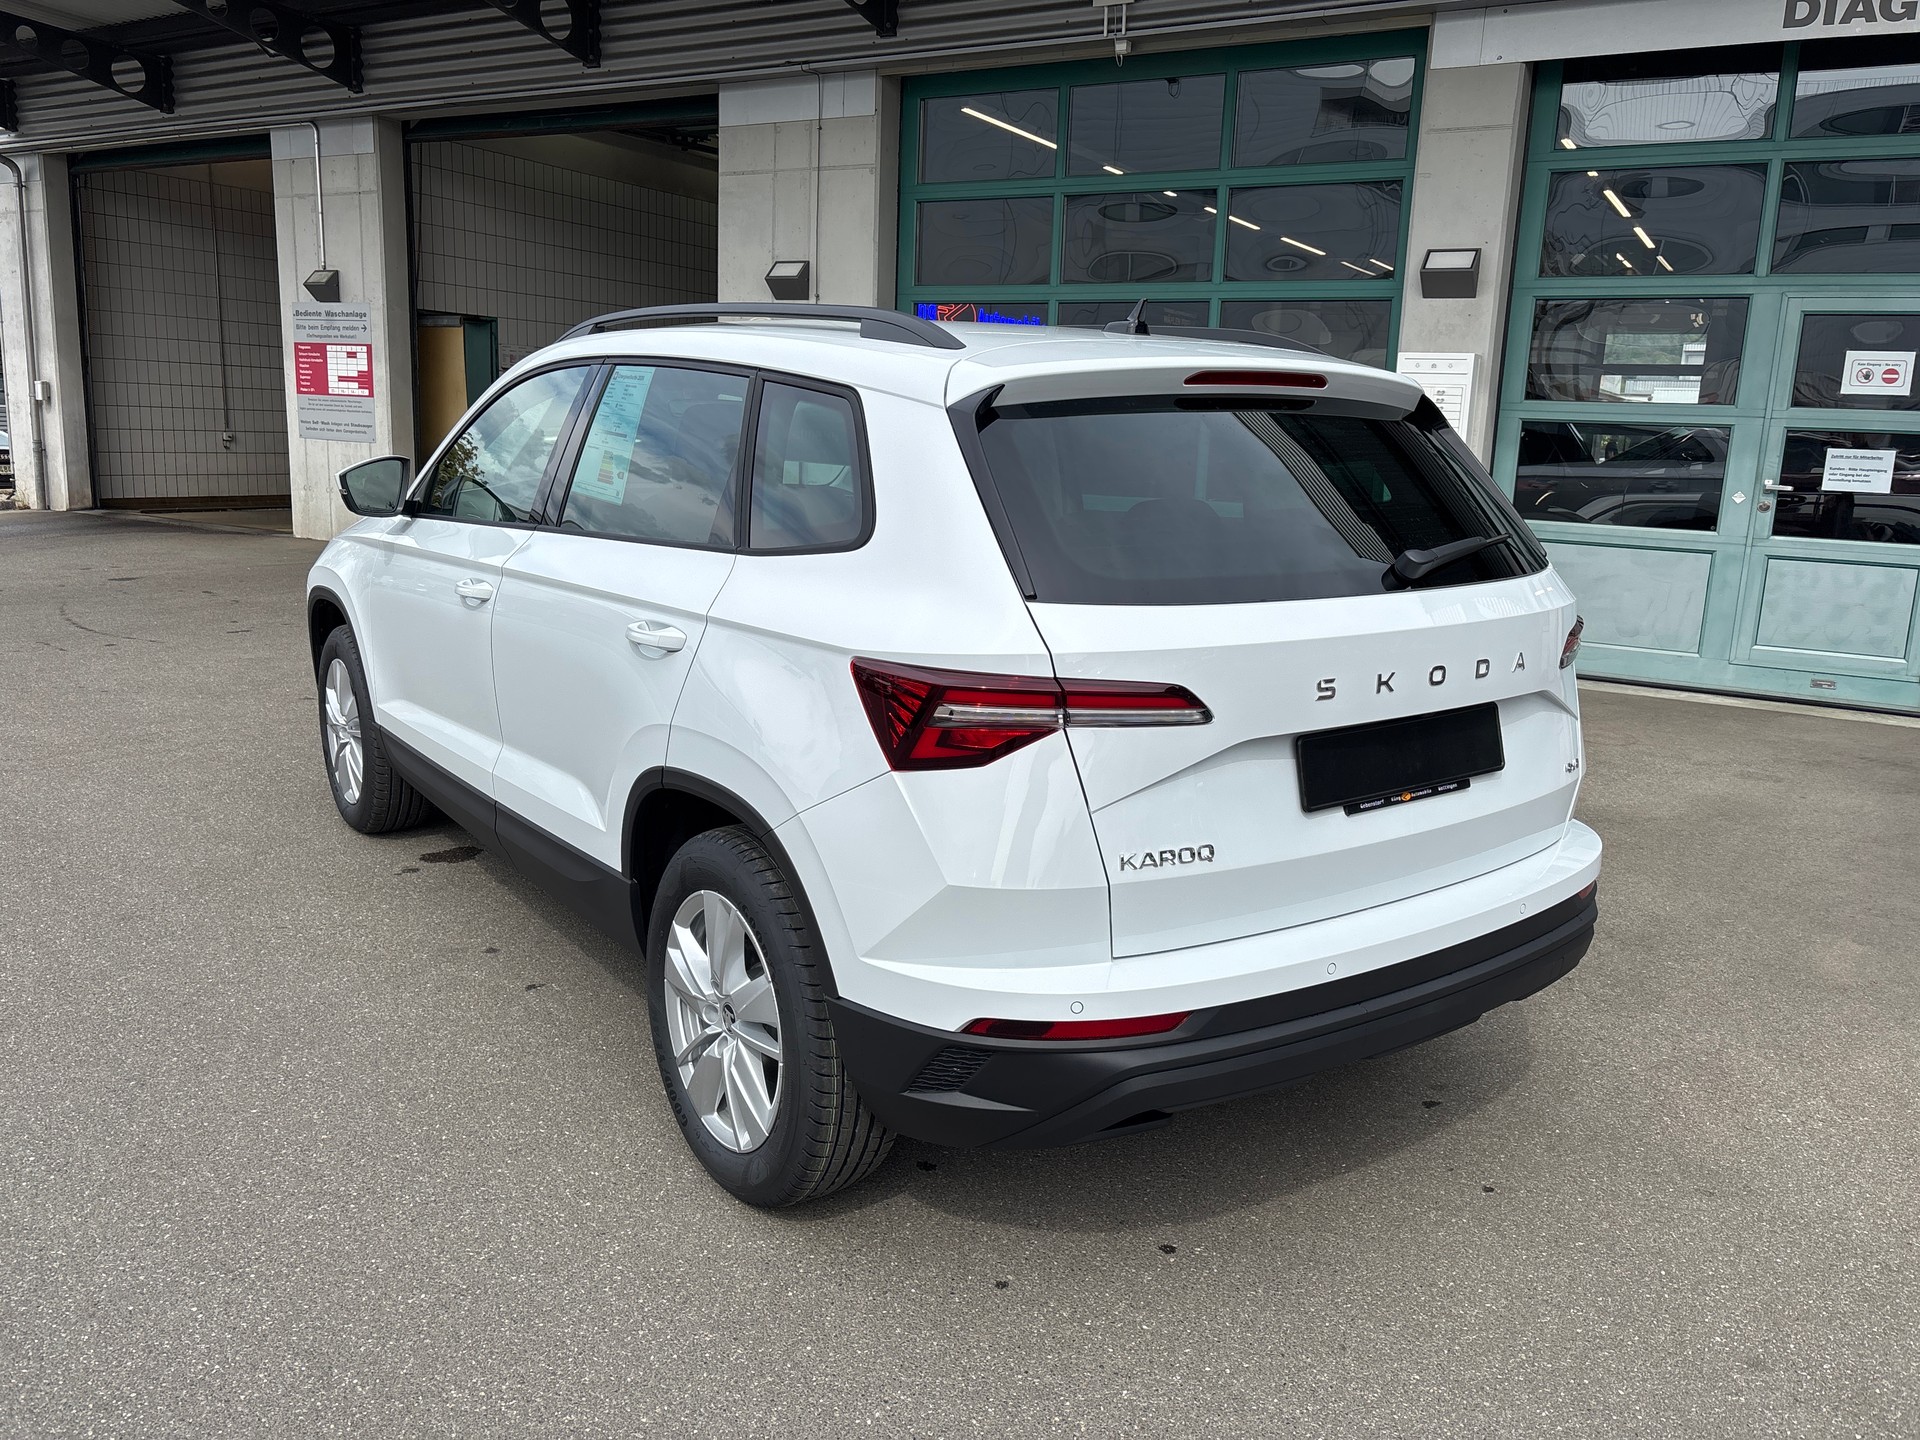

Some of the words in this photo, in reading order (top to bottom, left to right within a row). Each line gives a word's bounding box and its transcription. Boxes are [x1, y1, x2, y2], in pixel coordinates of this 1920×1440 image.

[324, 310, 367, 319] Waschanlage
[321, 324, 341, 332] Empfang
[1119, 843, 1215, 872] KAROQ
